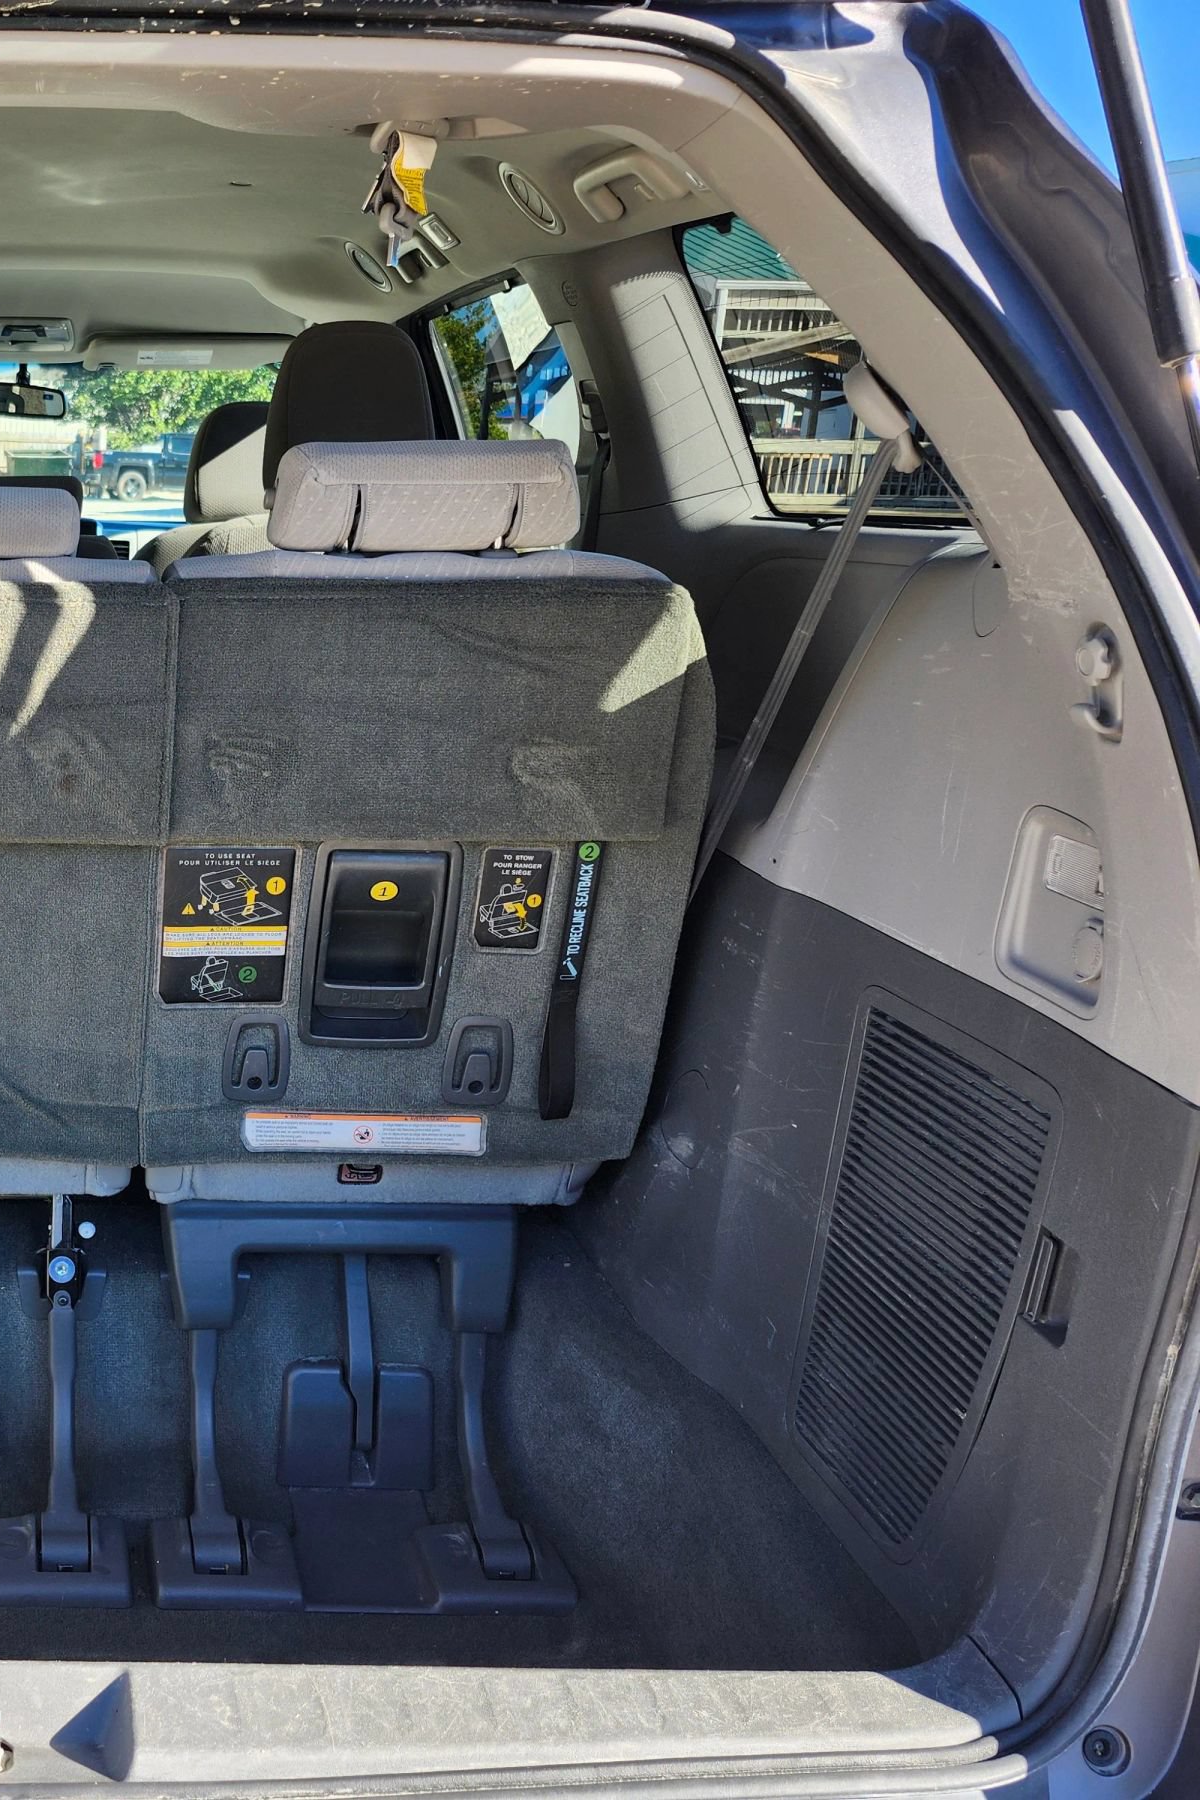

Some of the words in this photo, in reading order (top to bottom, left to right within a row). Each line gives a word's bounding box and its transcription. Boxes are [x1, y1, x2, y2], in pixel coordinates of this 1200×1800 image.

[584, 845, 594, 859] 2
[513, 862, 543, 870] RANGER
[575, 863, 594, 907] SEATBACK
[569, 908, 586, 943] RECLINE
[567, 944, 580, 956] TO
[243, 969, 253, 981] 2
